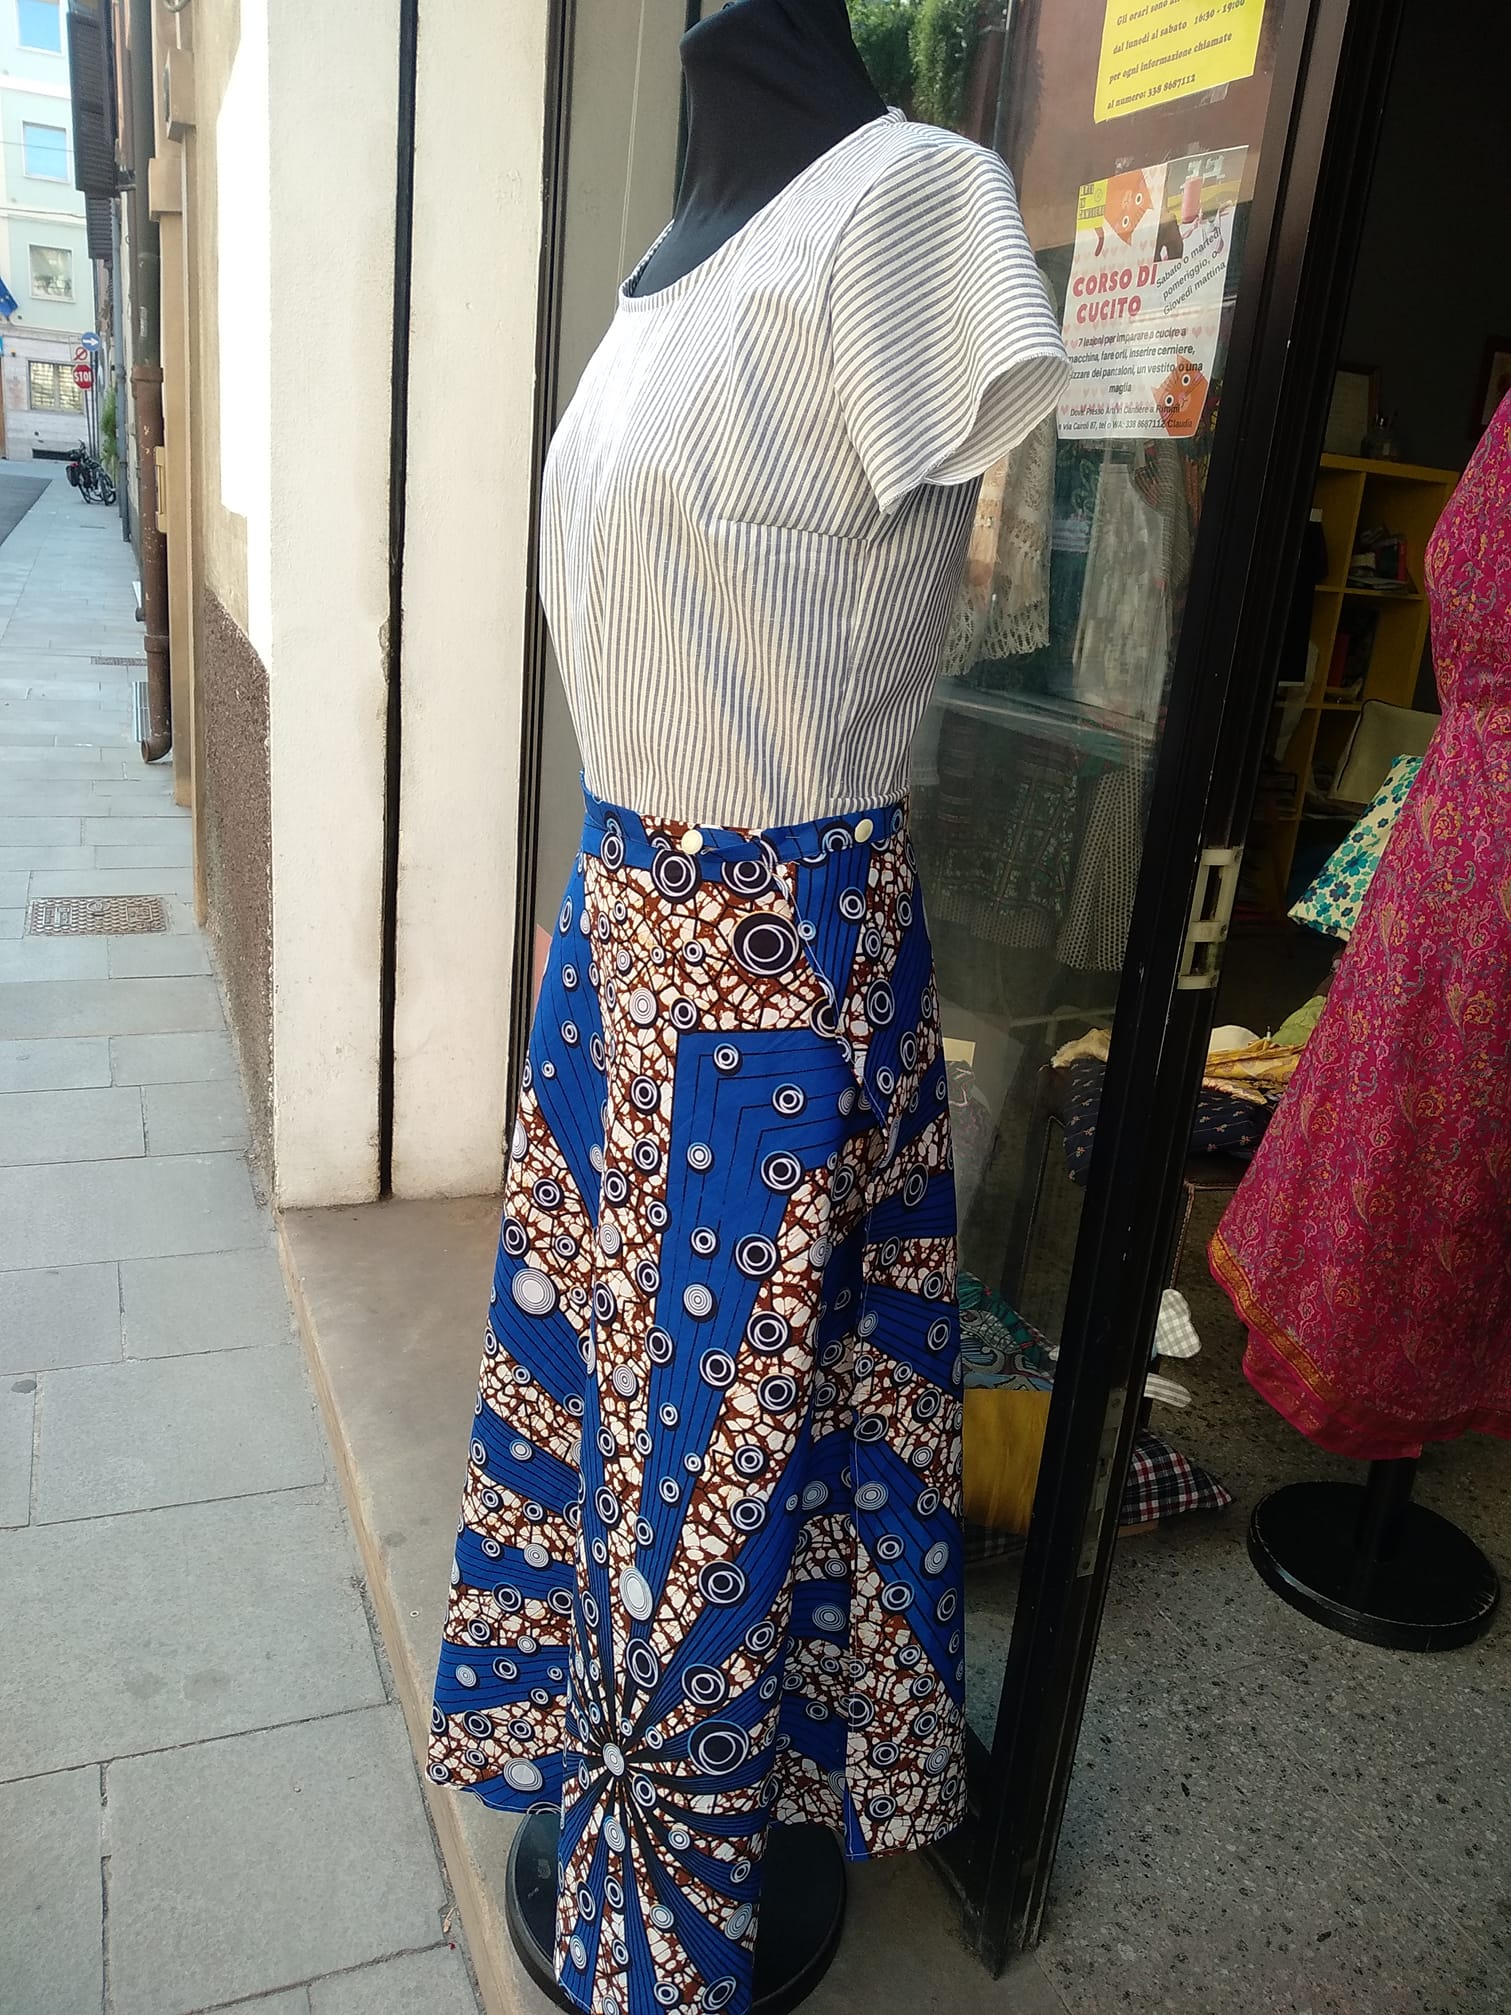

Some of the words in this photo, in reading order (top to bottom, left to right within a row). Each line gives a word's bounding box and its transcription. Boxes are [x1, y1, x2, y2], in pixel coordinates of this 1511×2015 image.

[1112, 42, 1123, 54] dal
[1151, 29, 1159, 40] al
[1160, 20, 1187, 36] sabato
[1193, 10, 1215, 25] 16:30
[1221, 0, 1245, 14] 19:00
[1116, 13, 1128, 26] Gli
[1129, 8, 1149, 23] orari
[1150, 1, 1168, 13] sono
[1108, 72, 1121, 84] per
[1122, 64, 1139, 79] ogni
[1140, 46, 1192, 71] informazione
[1193, 32, 1233, 53] chiamate
[1107, 98, 1114, 110] al
[1115, 89, 1146, 107] numero:
[1147, 82, 1162, 97] 338
[1163, 74, 1196, 92] 8687112
[1211, 250, 1218, 259] o
[1072, 268, 1132, 297] CORSO
[1137, 263, 1158, 288] DI
[1156, 261, 1182, 289] Sabato
[1183, 255, 1190, 264] o
[1194, 262, 1227, 291] mattina
[1076, 295, 1141, 324] CUCITO
[1078, 337, 1083, 347] 7
[1104, 335, 1116, 346] per
[1117, 331, 1149, 344] imparare
[1155, 328, 1180, 339] cucire
[1100, 350, 1114, 361] fare
[1129, 346, 1157, 358] inserire
[1157, 344, 1195, 357] cerniere,
[1091, 367, 1102, 378] dei
[1137, 366, 1146, 374] un
[1185, 363, 1203, 372] una
[1108, 384, 1132, 395] maglia
